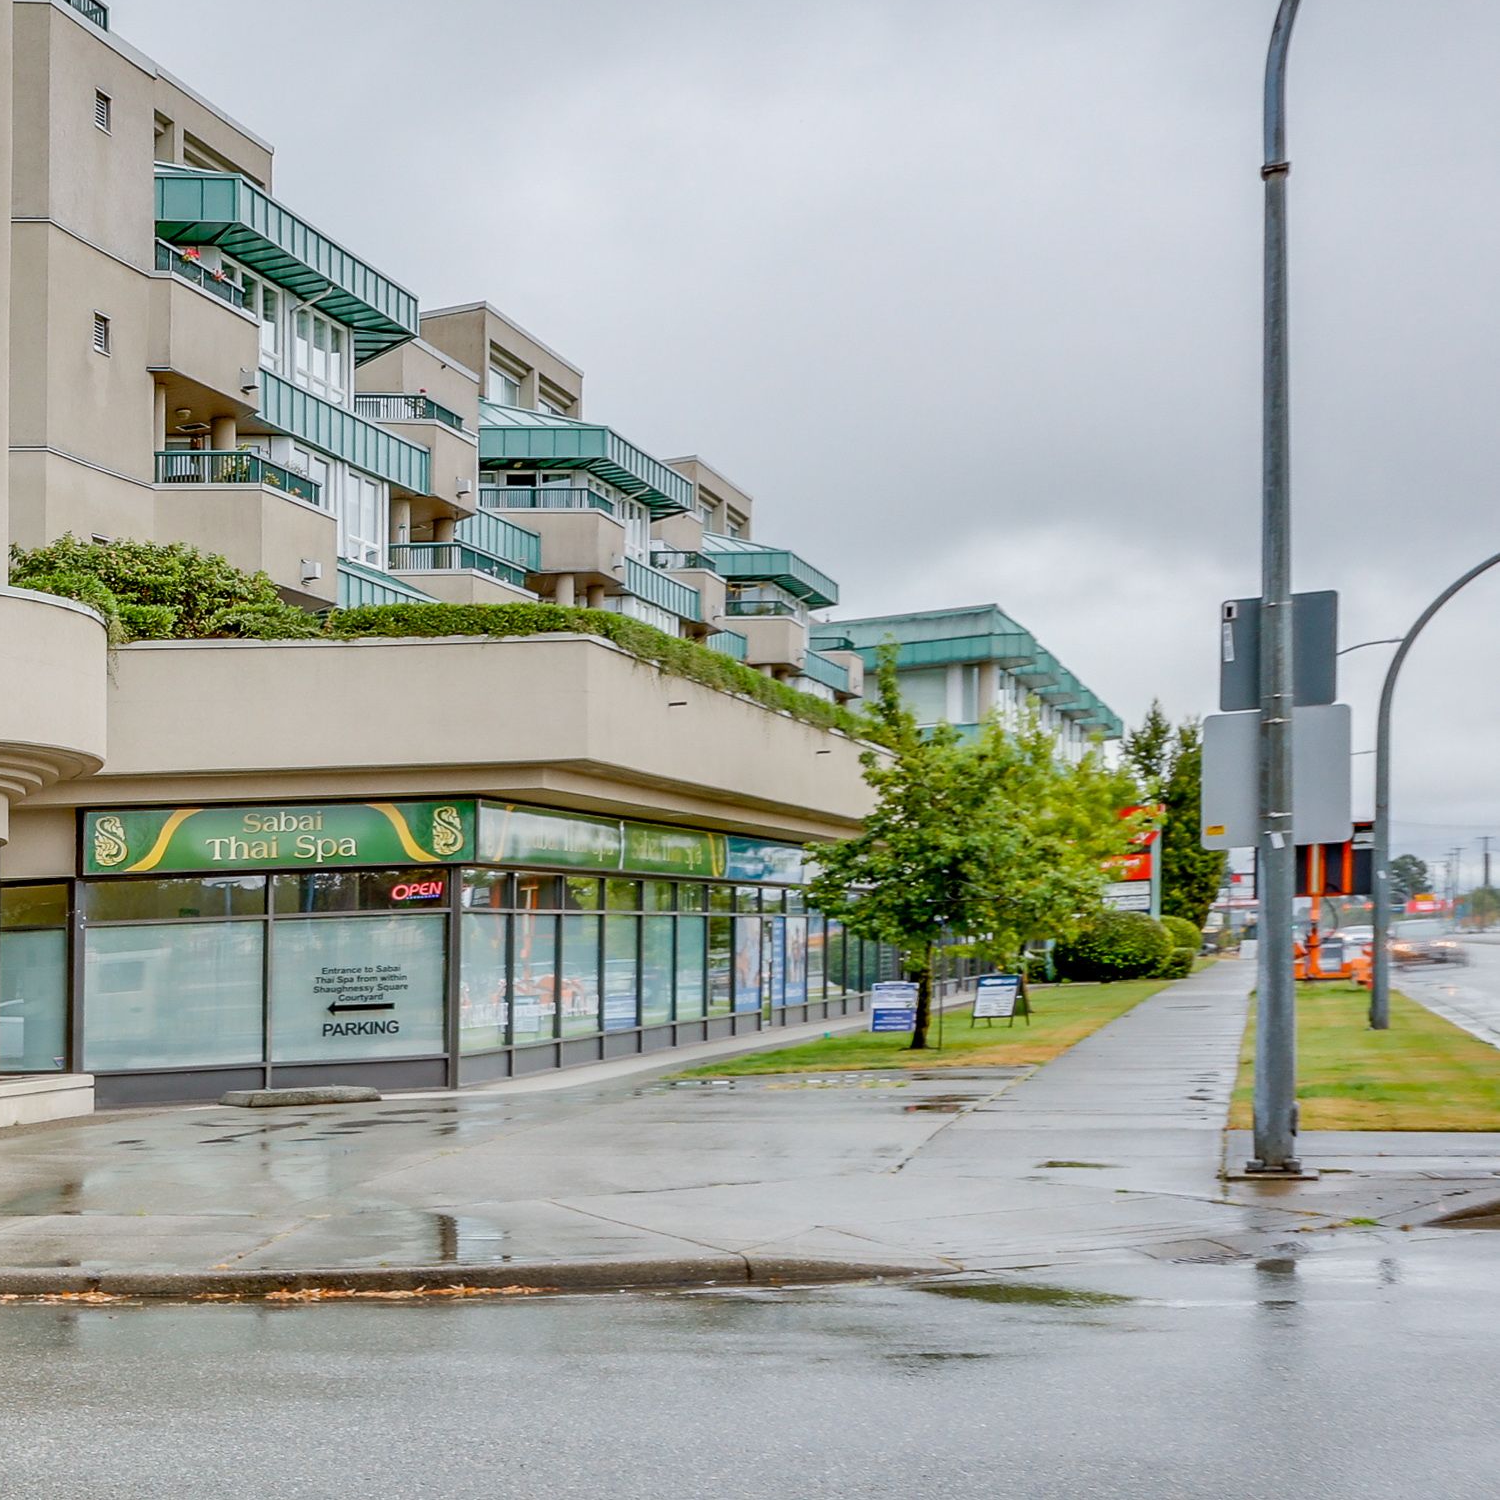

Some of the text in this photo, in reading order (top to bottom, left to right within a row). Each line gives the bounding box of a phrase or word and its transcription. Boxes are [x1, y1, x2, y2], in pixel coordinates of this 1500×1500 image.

[242, 810, 323, 833] Sabai
[205, 835, 358, 863] Thai Spa
[391, 881, 443, 900] OPEN
[321, 967, 362, 975] Entrance
[376, 964, 401, 973] Sabai
[315, 976, 335, 984] Thai
[336, 975, 355, 985] Spa
[380, 974, 408, 982] within
[313, 983, 409, 994] Shaughnessy Square
[338, 993, 384, 1002] Courtyard
[322, 1020, 400, 1037] PARKING
